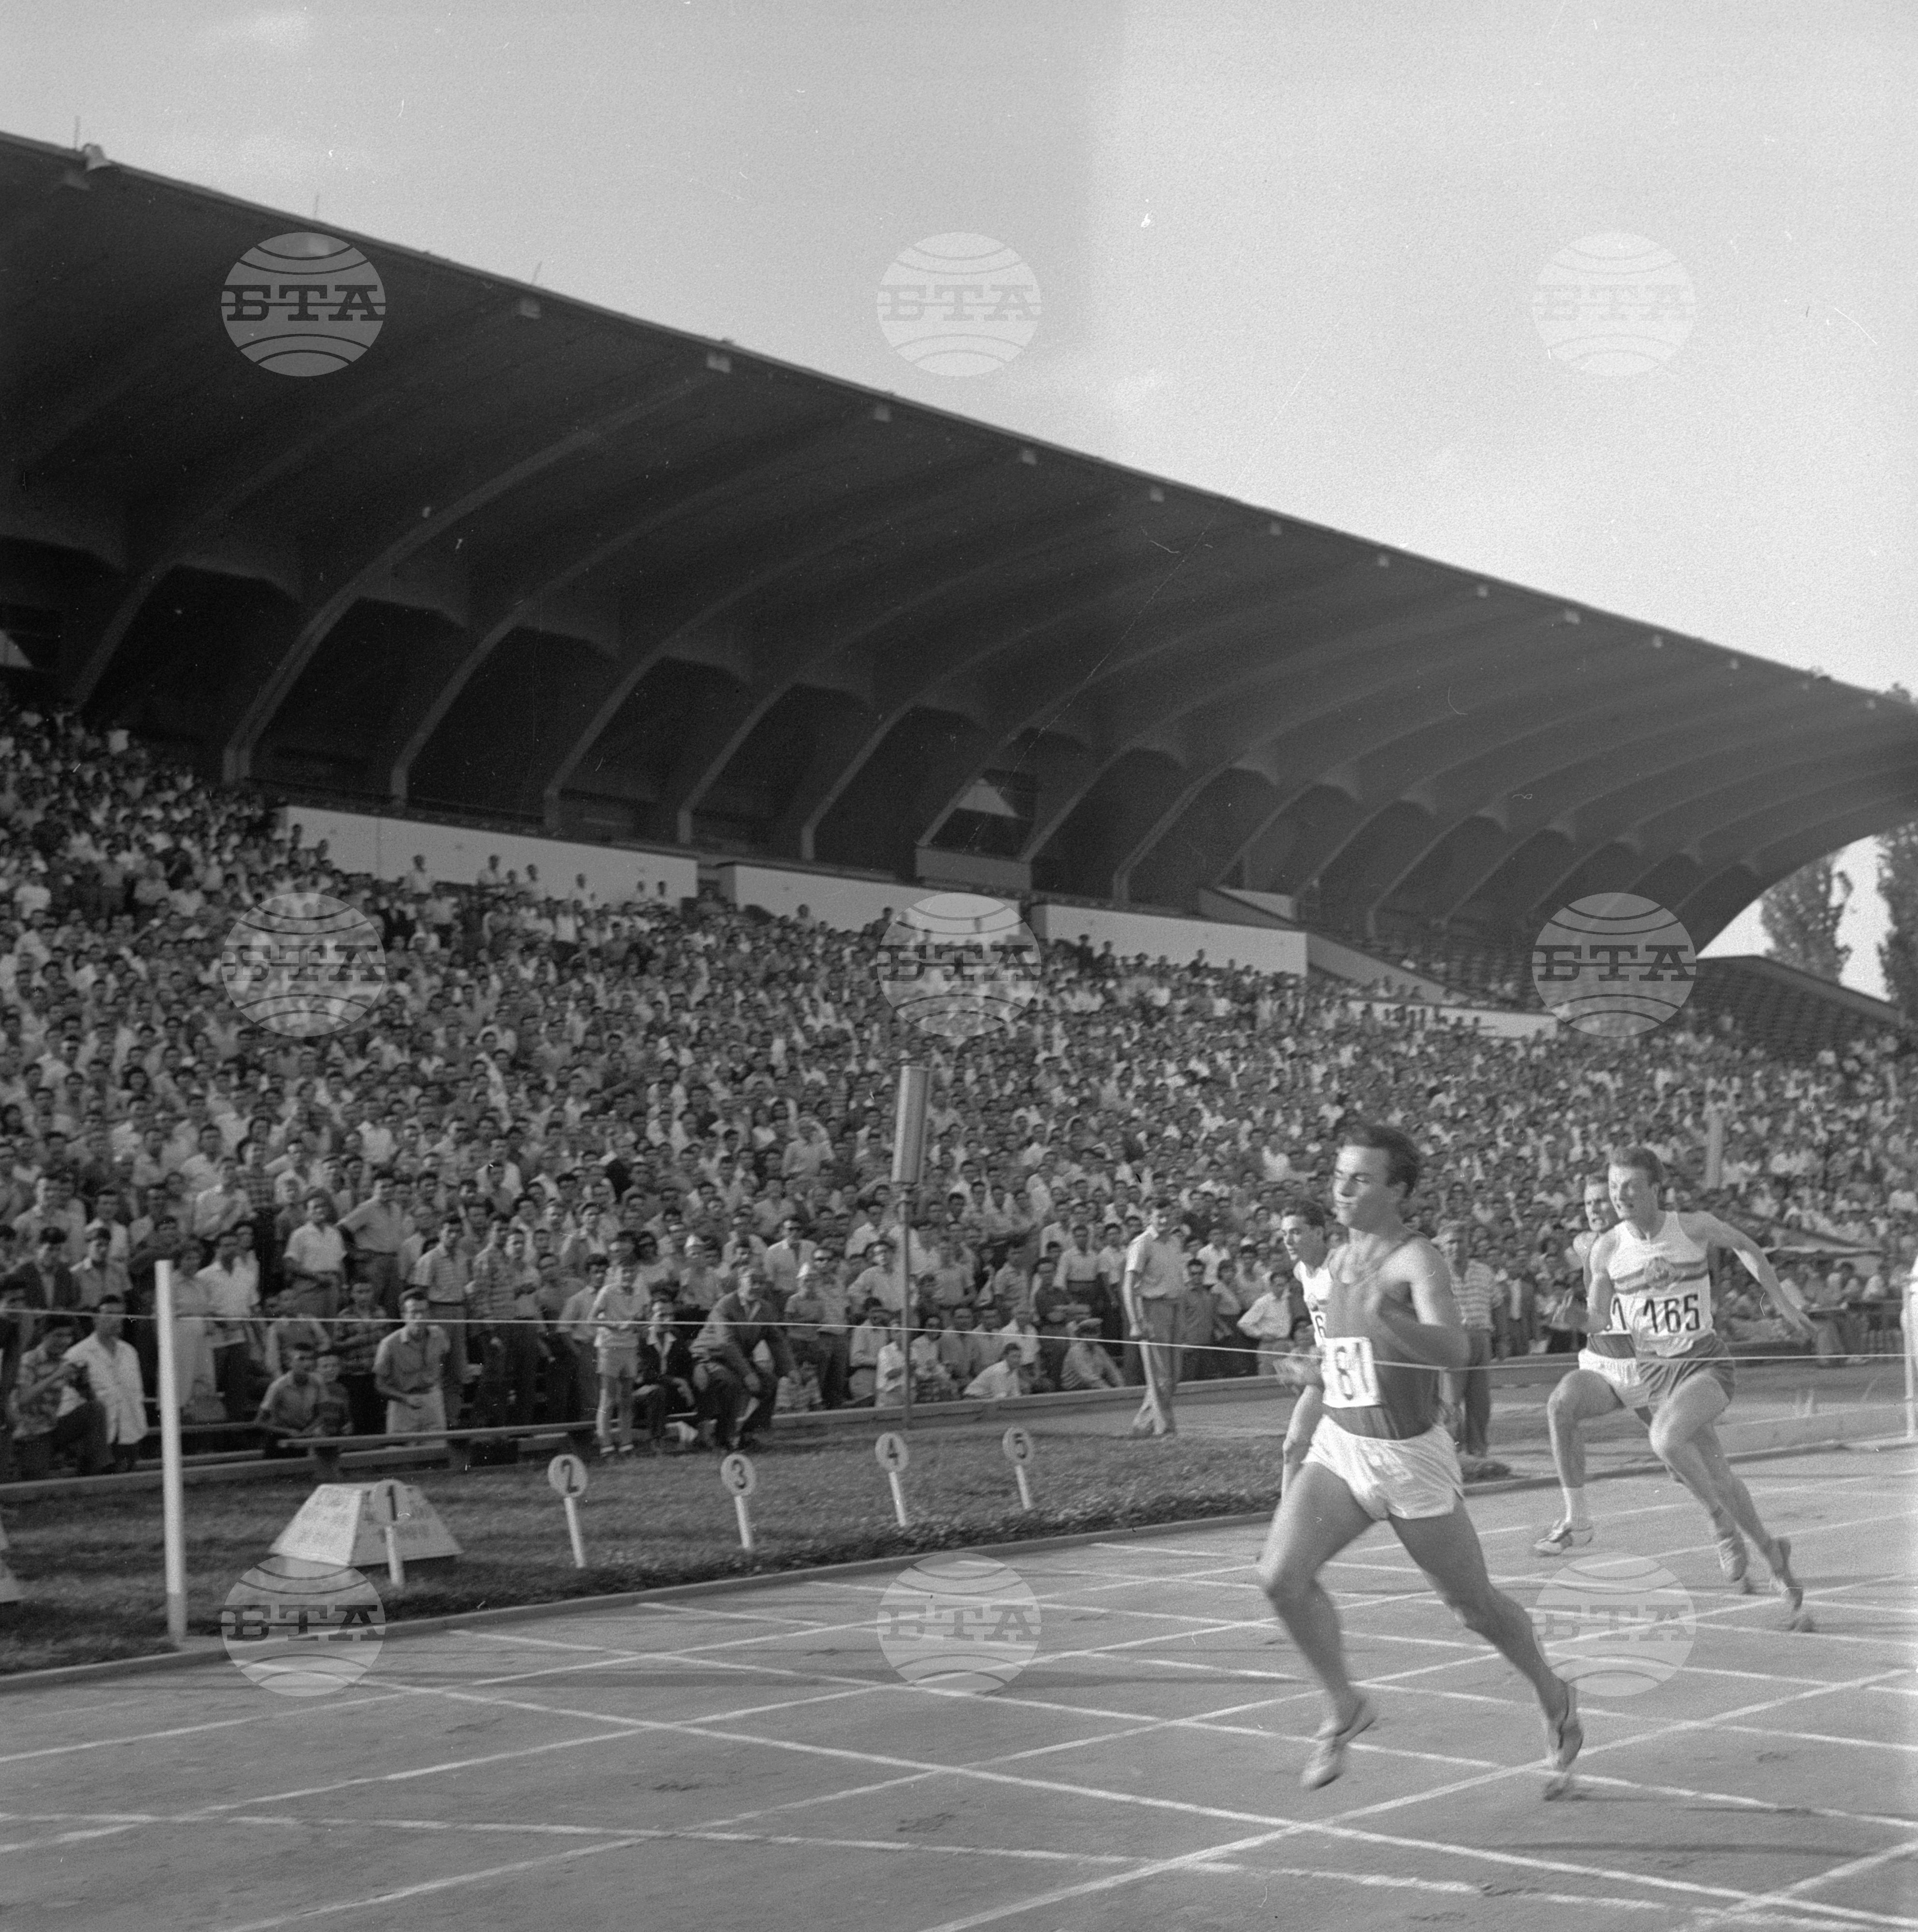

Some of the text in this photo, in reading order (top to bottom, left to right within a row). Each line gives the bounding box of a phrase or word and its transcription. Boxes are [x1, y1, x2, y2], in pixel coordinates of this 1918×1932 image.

[1643, 1294, 1700, 1334] 165
[1335, 1342, 1369, 1400] 61
[887, 1438, 899, 1465] 4
[1014, 1433, 1028, 1459] 5
[561, 1459, 580, 1493] 2
[731, 1459, 747, 1490] 3
[387, 1484, 398, 1521] 1
